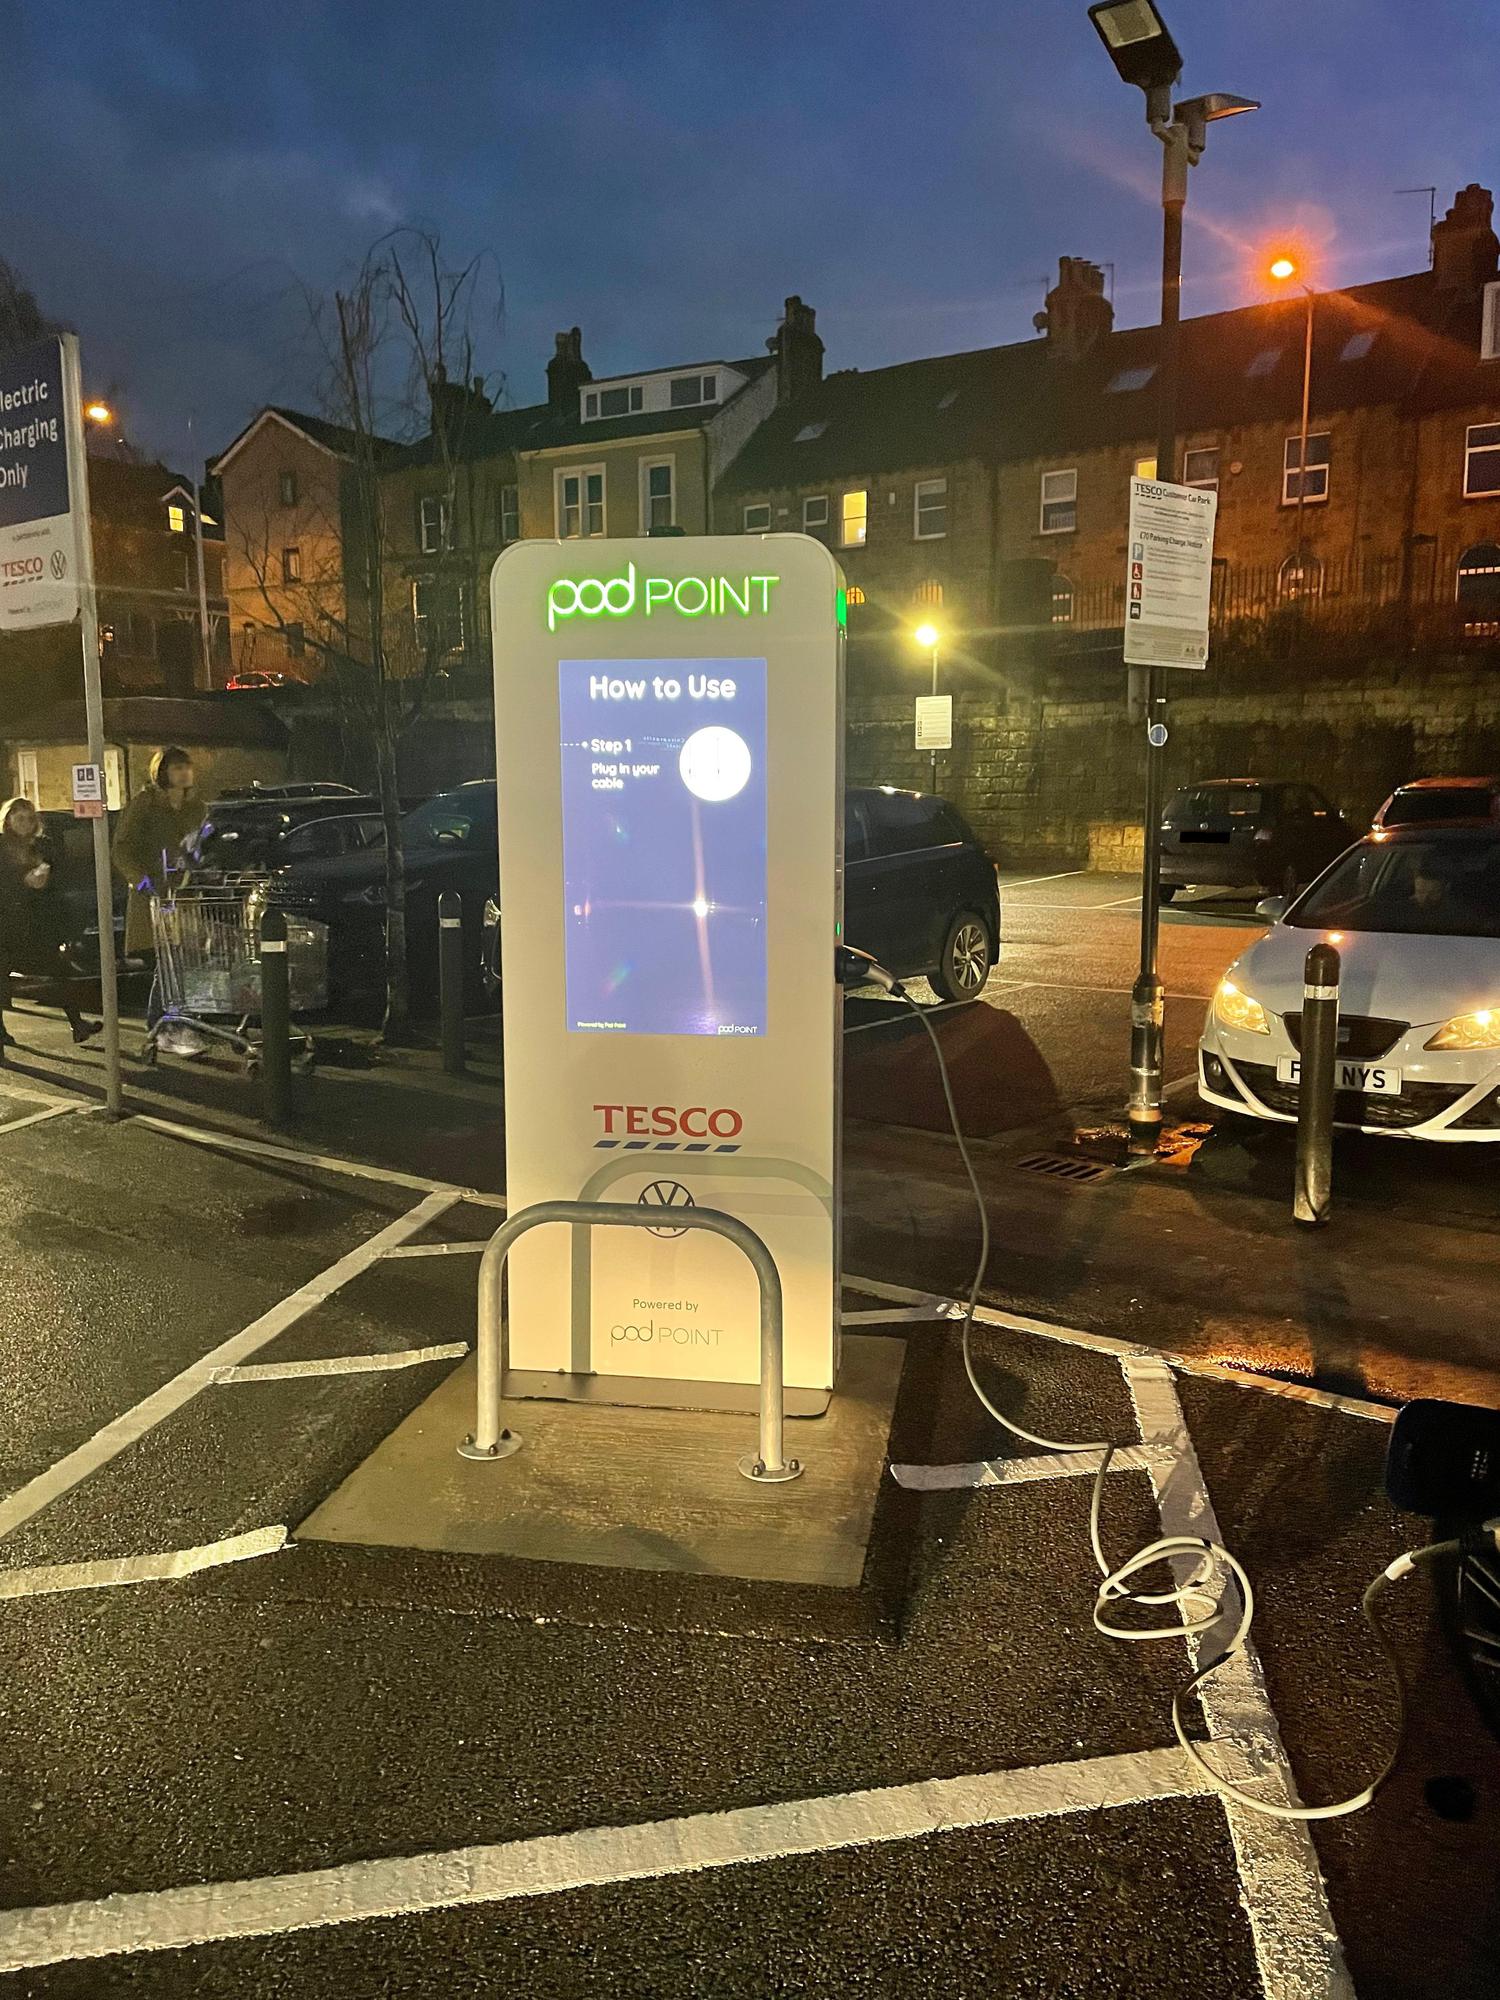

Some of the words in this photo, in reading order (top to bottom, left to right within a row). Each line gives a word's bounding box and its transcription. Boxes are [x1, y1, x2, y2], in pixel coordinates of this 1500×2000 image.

[0, 379, 48, 412] lectric
[0, 462, 28, 489] Only
[1135, 483, 1162, 496] TESCO
[1, 557, 43, 577] TESCO
[548, 561, 635, 632] pod
[646, 576, 780, 616] POINT
[589, 675, 646, 700] How
[652, 676, 681, 699] to
[688, 674, 737, 698] Use
[591, 738, 623, 755] Step
[624, 738, 632, 753] 1
[591, 763, 617, 777] Plug
[619, 763, 630, 775] in
[632, 764, 660, 777] your
[591, 776, 625, 790] cable
[717, 1024, 735, 1035] pod
[735, 1026, 758, 1034] POINT
[1342, 1065, 1386, 1089] NYS
[593, 1104, 743, 1138] TESCO
[632, 1298, 682, 1311] Powered
[685, 1300, 699, 1312] by
[610, 1319, 653, 1347] pod
[658, 1327, 724, 1345] POINT
